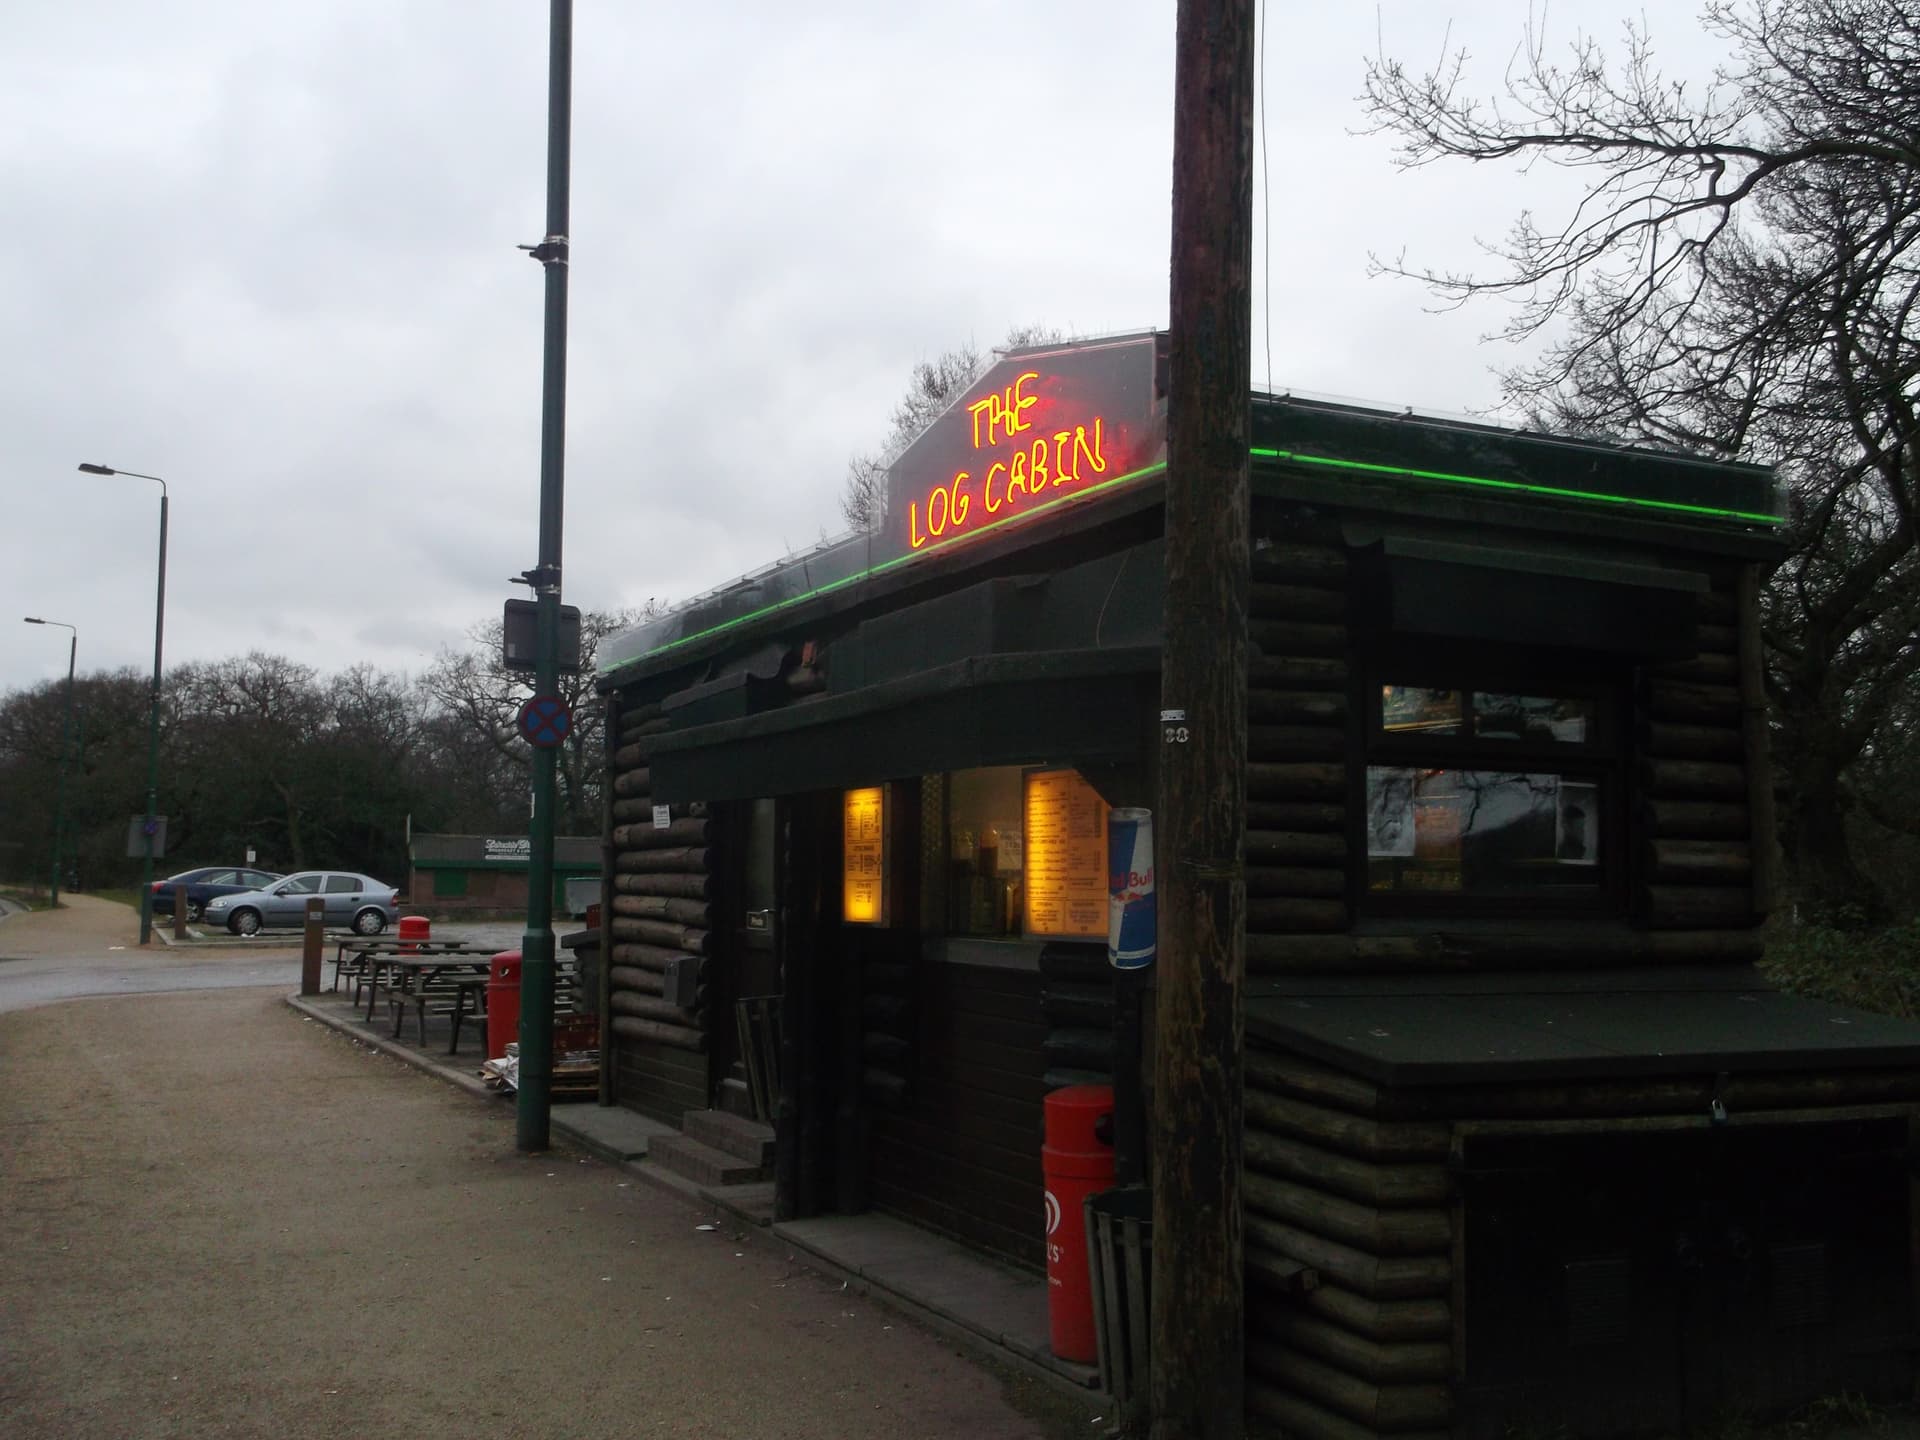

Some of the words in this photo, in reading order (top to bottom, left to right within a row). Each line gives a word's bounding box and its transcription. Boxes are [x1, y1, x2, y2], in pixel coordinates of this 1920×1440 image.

[968, 372, 1038, 449] THE
[911, 472, 970, 548] LOG
[984, 418, 1106, 513] CABIN
[1129, 867, 1153, 887] Bull
